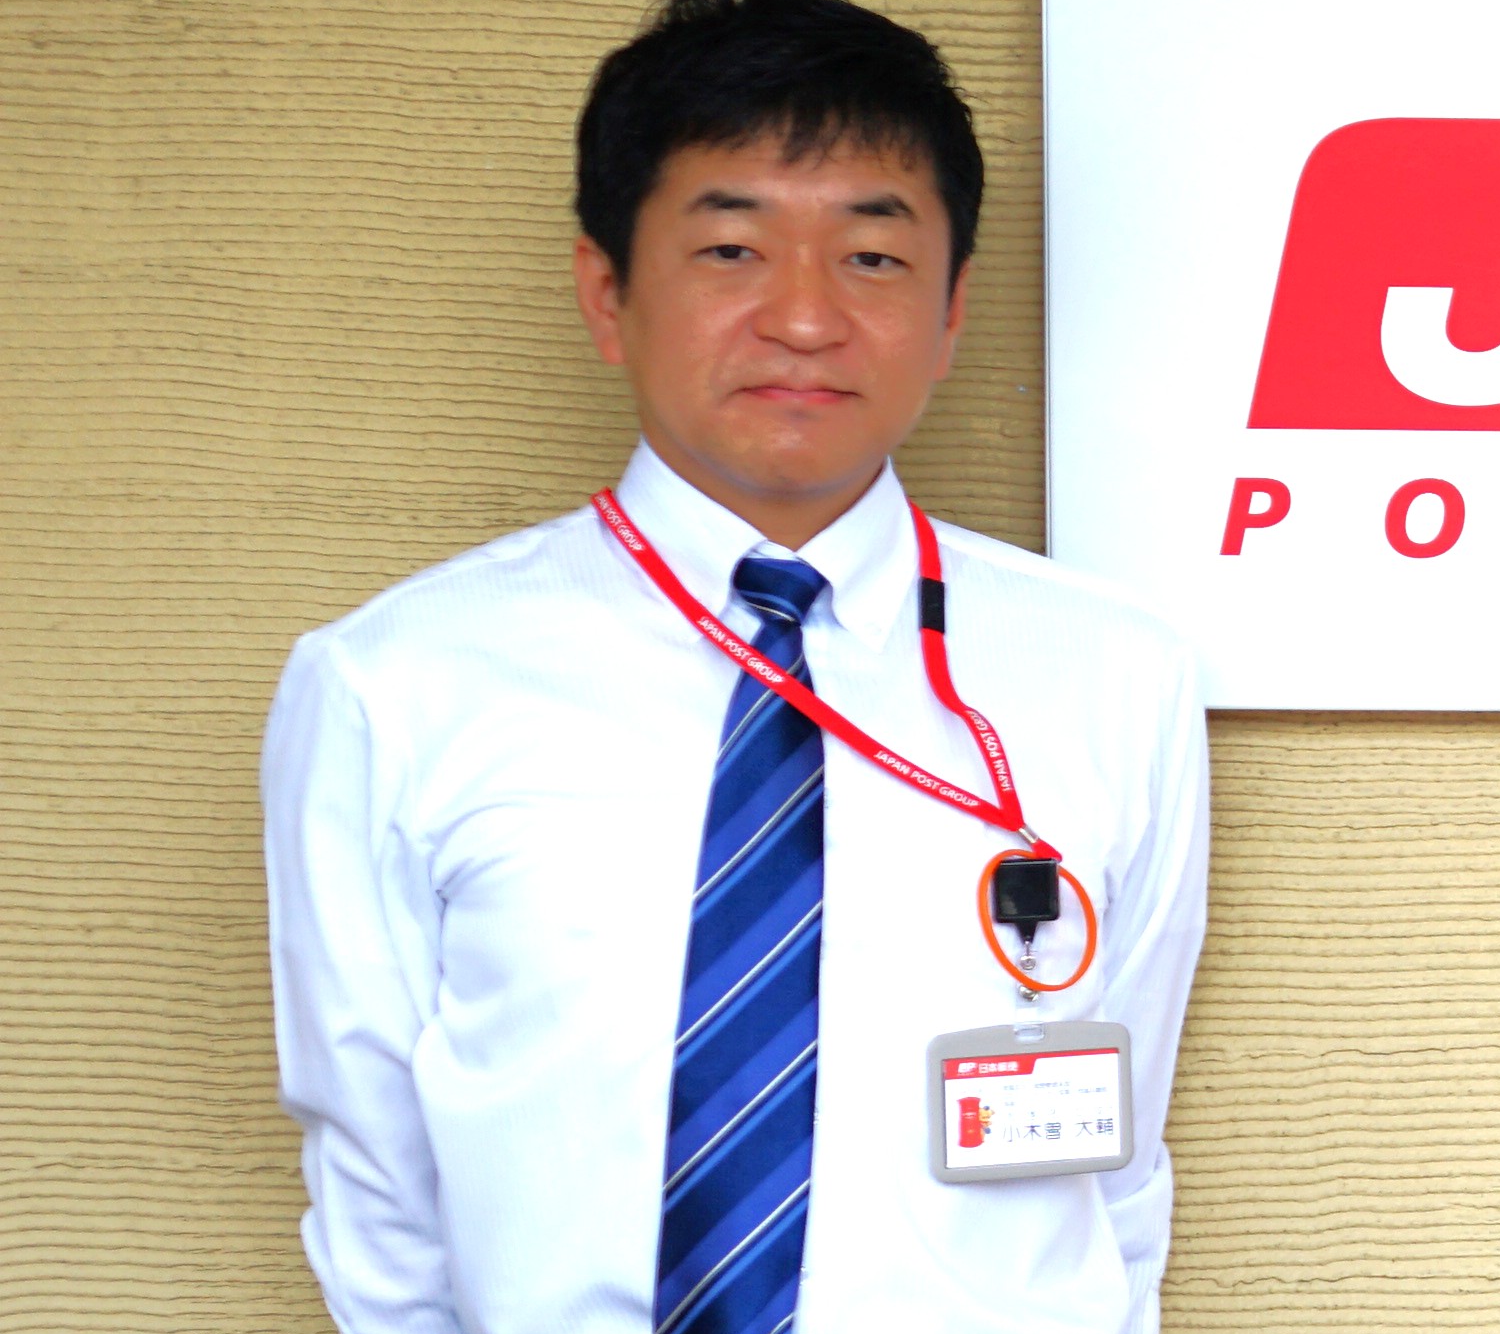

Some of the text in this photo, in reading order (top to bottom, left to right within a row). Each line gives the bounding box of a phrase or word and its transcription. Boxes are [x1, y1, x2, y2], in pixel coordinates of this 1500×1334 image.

[724, 638, 753, 660] POST
[747, 657, 785, 683] GROUP
[874, 750, 980, 806] JAPAN POST GROUP
